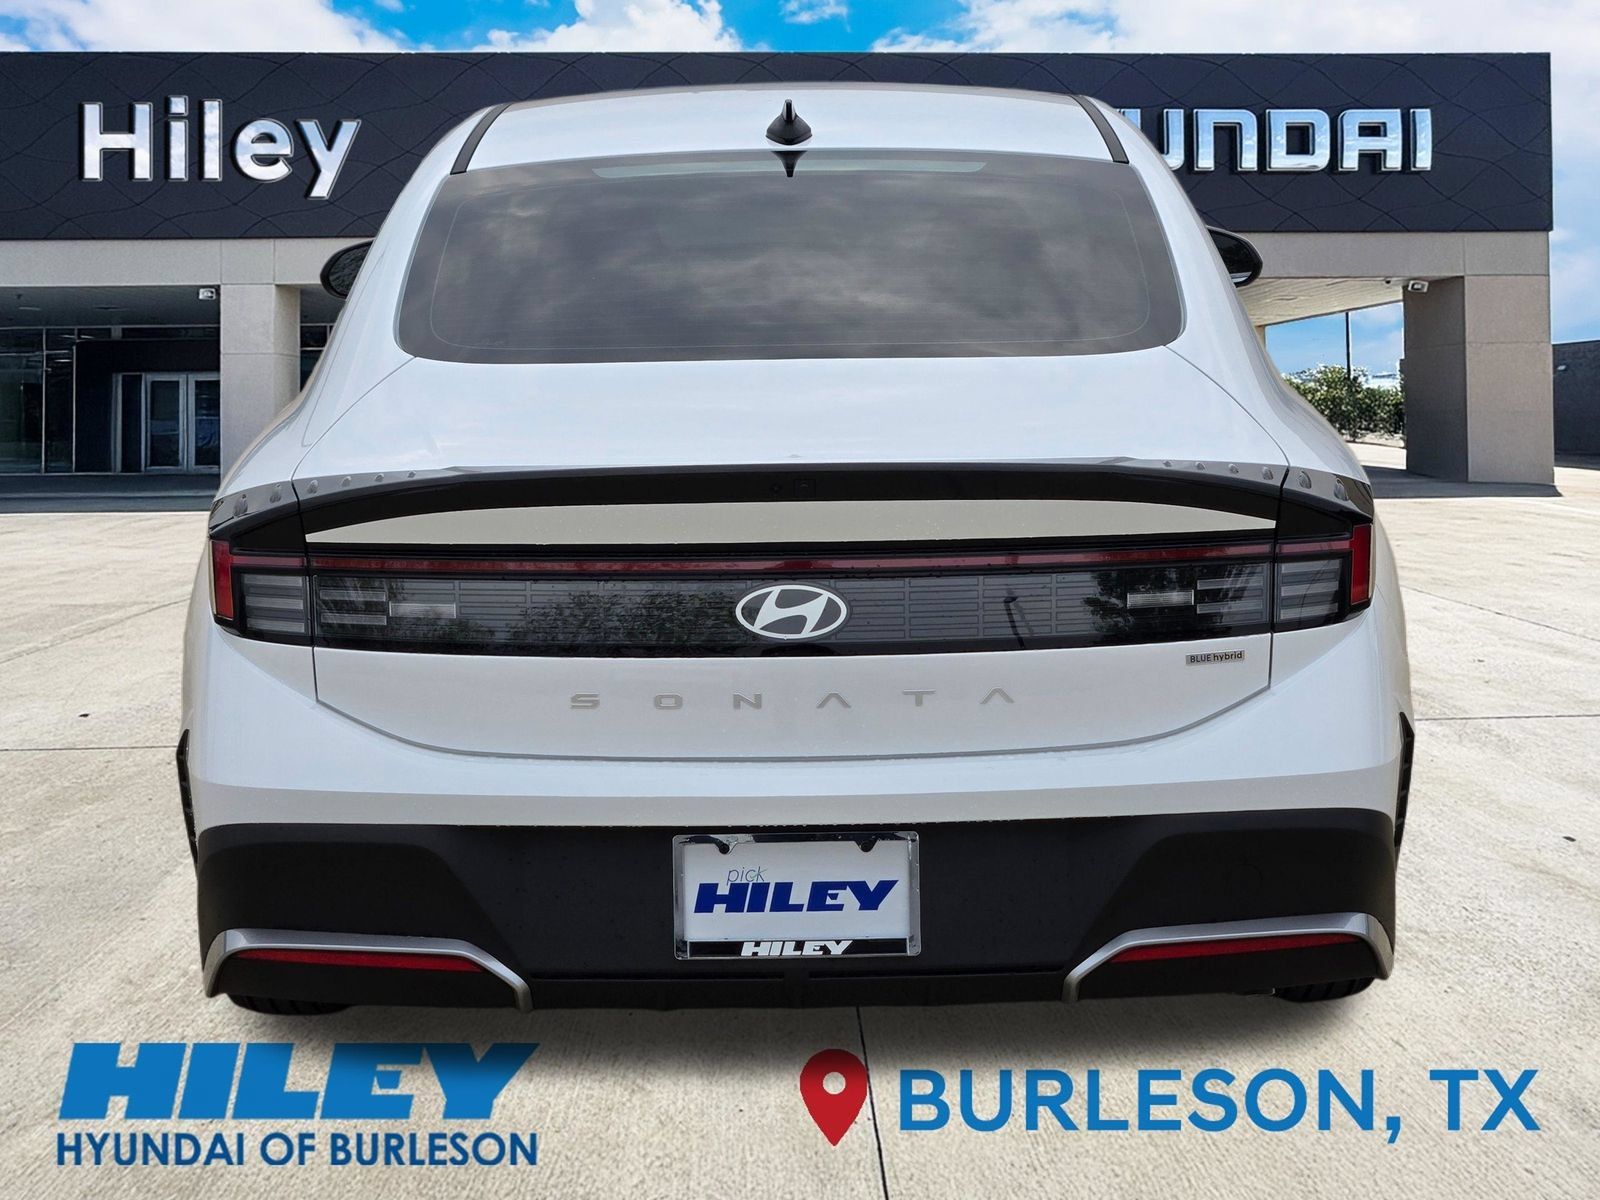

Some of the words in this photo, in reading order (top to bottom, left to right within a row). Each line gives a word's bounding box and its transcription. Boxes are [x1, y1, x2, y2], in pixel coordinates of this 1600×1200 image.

[79, 95, 362, 200] Hiley
[1190, 655, 1211, 663] BLUE
[1213, 652, 1242, 661] hybrid
[570, 687, 1015, 710] SONATA
[726, 866, 769, 886] pick
[694, 880, 899, 913] HILEY
[740, 940, 853, 957] HILEY
